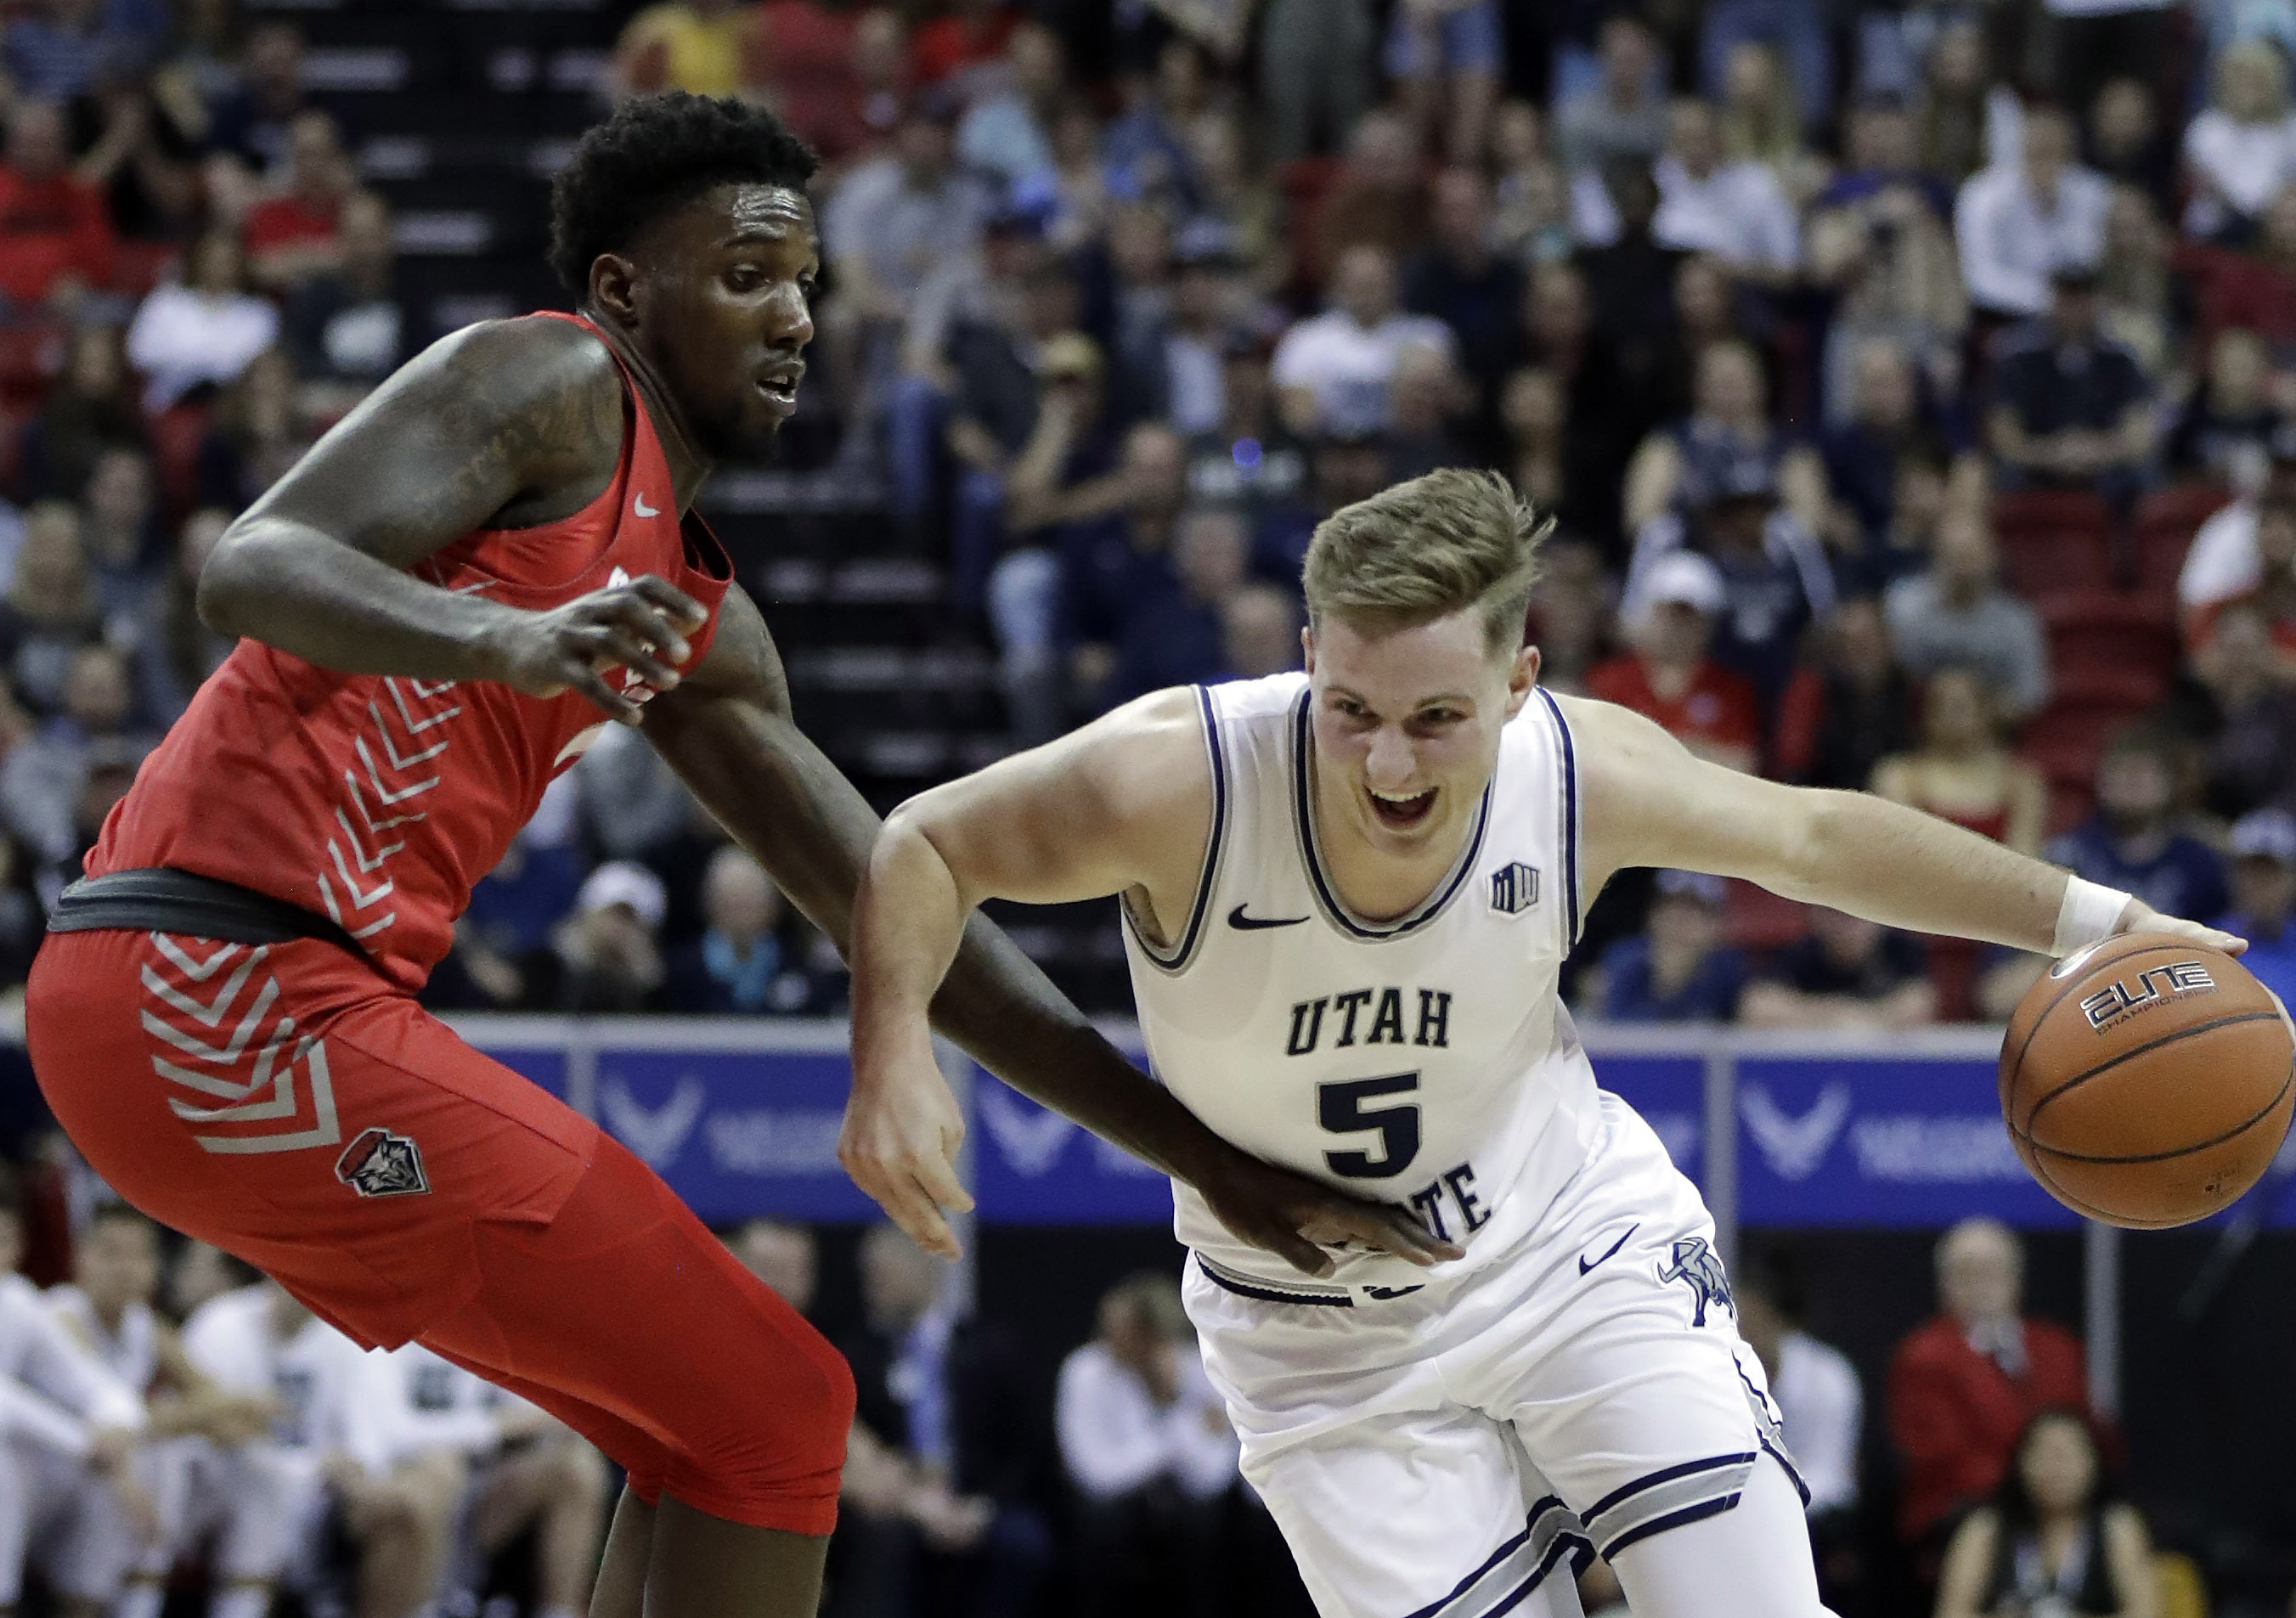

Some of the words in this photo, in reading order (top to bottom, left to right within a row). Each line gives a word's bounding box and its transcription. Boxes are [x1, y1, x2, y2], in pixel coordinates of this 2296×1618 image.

[1286, 987, 1453, 1057] UTAH
[2080, 961, 2215, 1029] ELITE
[1315, 1068, 1422, 1179] 5
